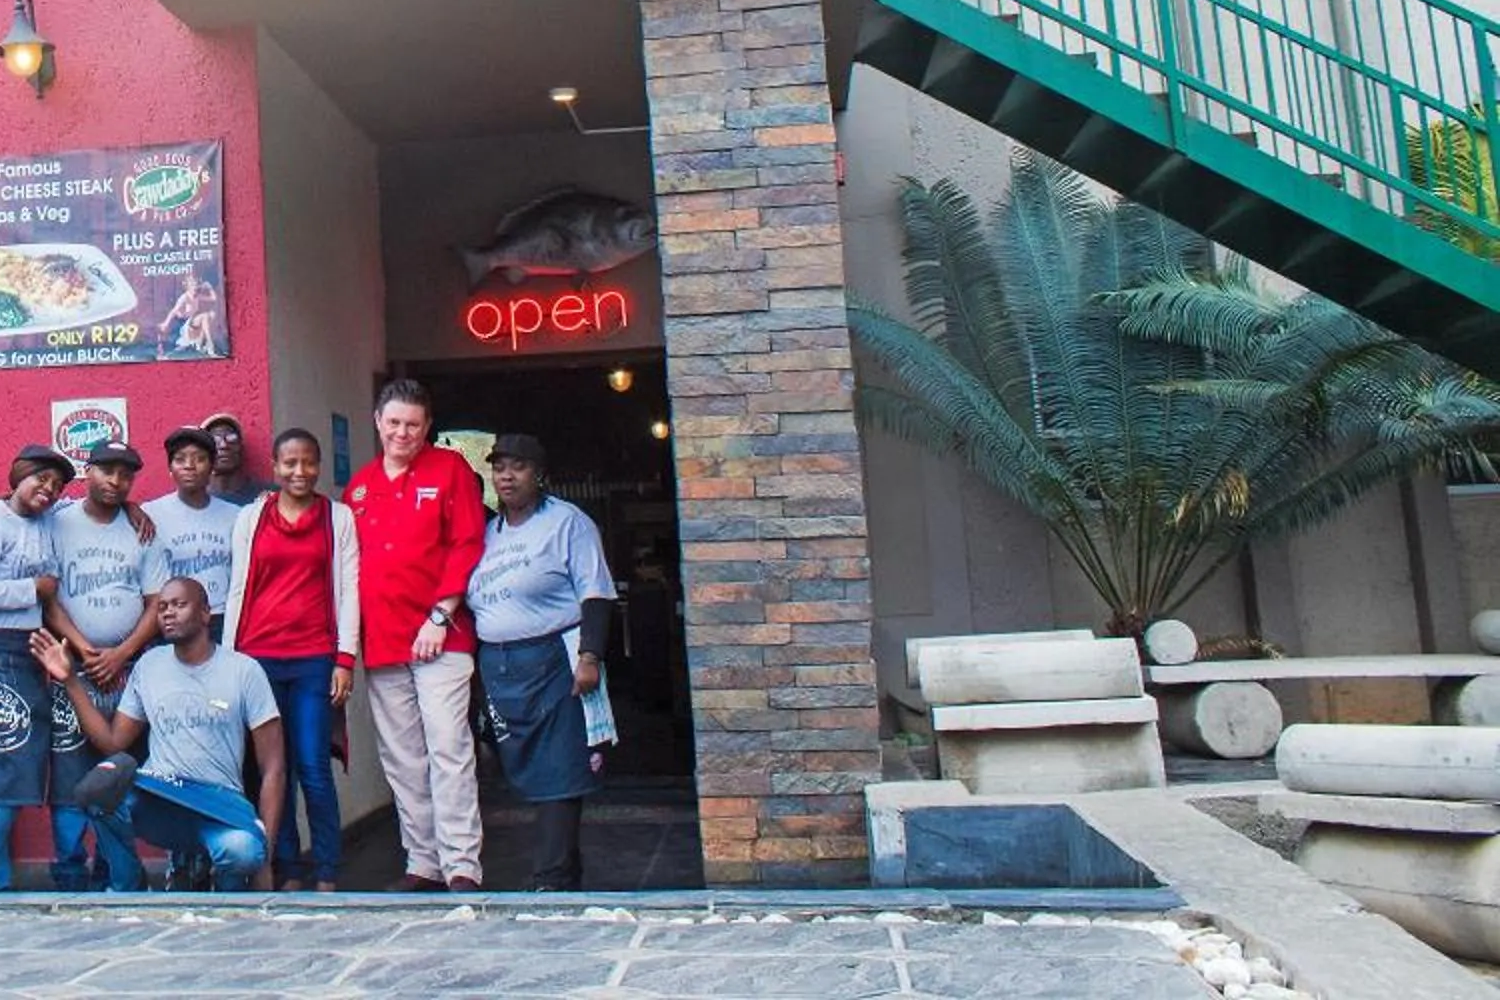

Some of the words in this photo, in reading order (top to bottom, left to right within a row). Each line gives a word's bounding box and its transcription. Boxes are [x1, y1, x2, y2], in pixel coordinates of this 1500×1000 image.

[1, 181, 61, 201] CHEESE
[65, 177, 113, 197] STEAK
[20, 206, 32, 222] &
[36, 205, 70, 223] Veg
[113, 232, 155, 251] PLUS
[160, 231, 174, 249] A
[179, 227, 219, 247] FREE
[467, 291, 627, 351] open
[47, 329, 86, 346] ONLY
[91, 323, 139, 345] R129
[12, 351, 33, 365] for
[36, 351, 73, 367] your
[77, 347, 134, 362] BUCK...
